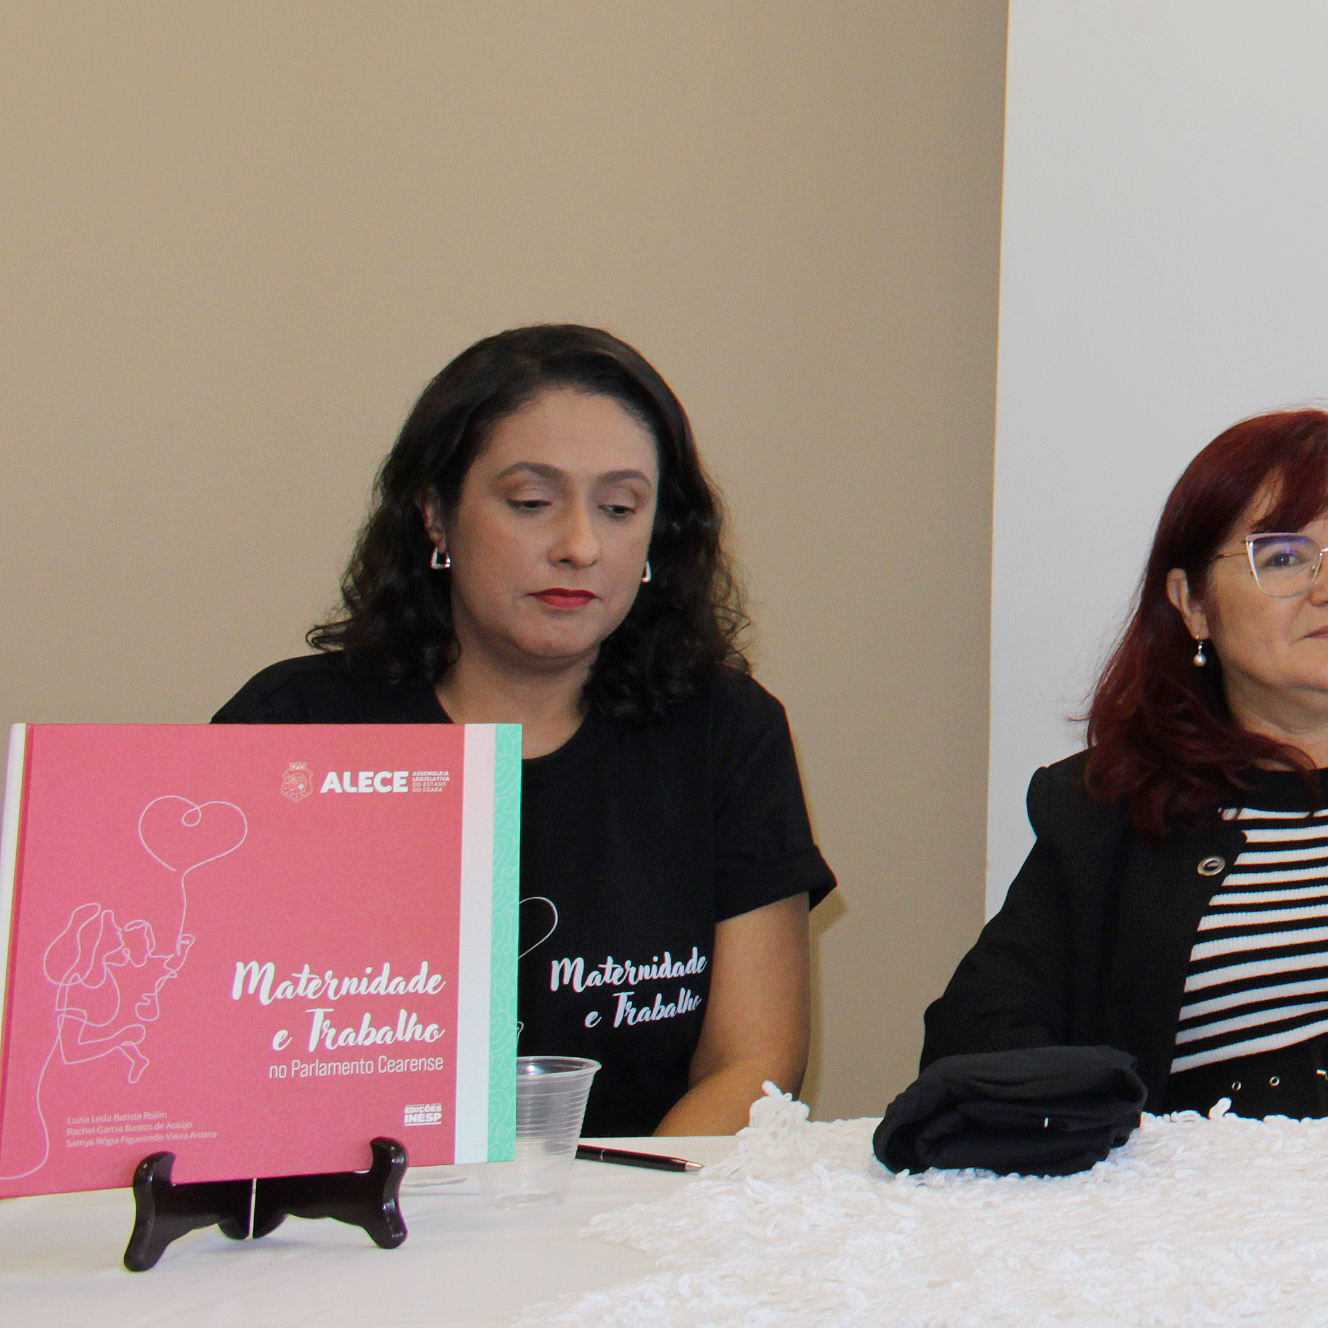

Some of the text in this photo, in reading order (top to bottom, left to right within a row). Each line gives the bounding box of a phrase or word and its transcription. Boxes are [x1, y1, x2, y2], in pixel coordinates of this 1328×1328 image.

[319, 771, 410, 793] ALECE
[550, 946, 708, 993] Maternidade
[231, 960, 446, 1006] Maternidade
[272, 1008, 445, 1052] e Trabalho
[584, 1011, 603, 1028] e
[269, 1055, 444, 1078] no Parlamento Cearense
[404, 1113, 442, 1122] INESP
